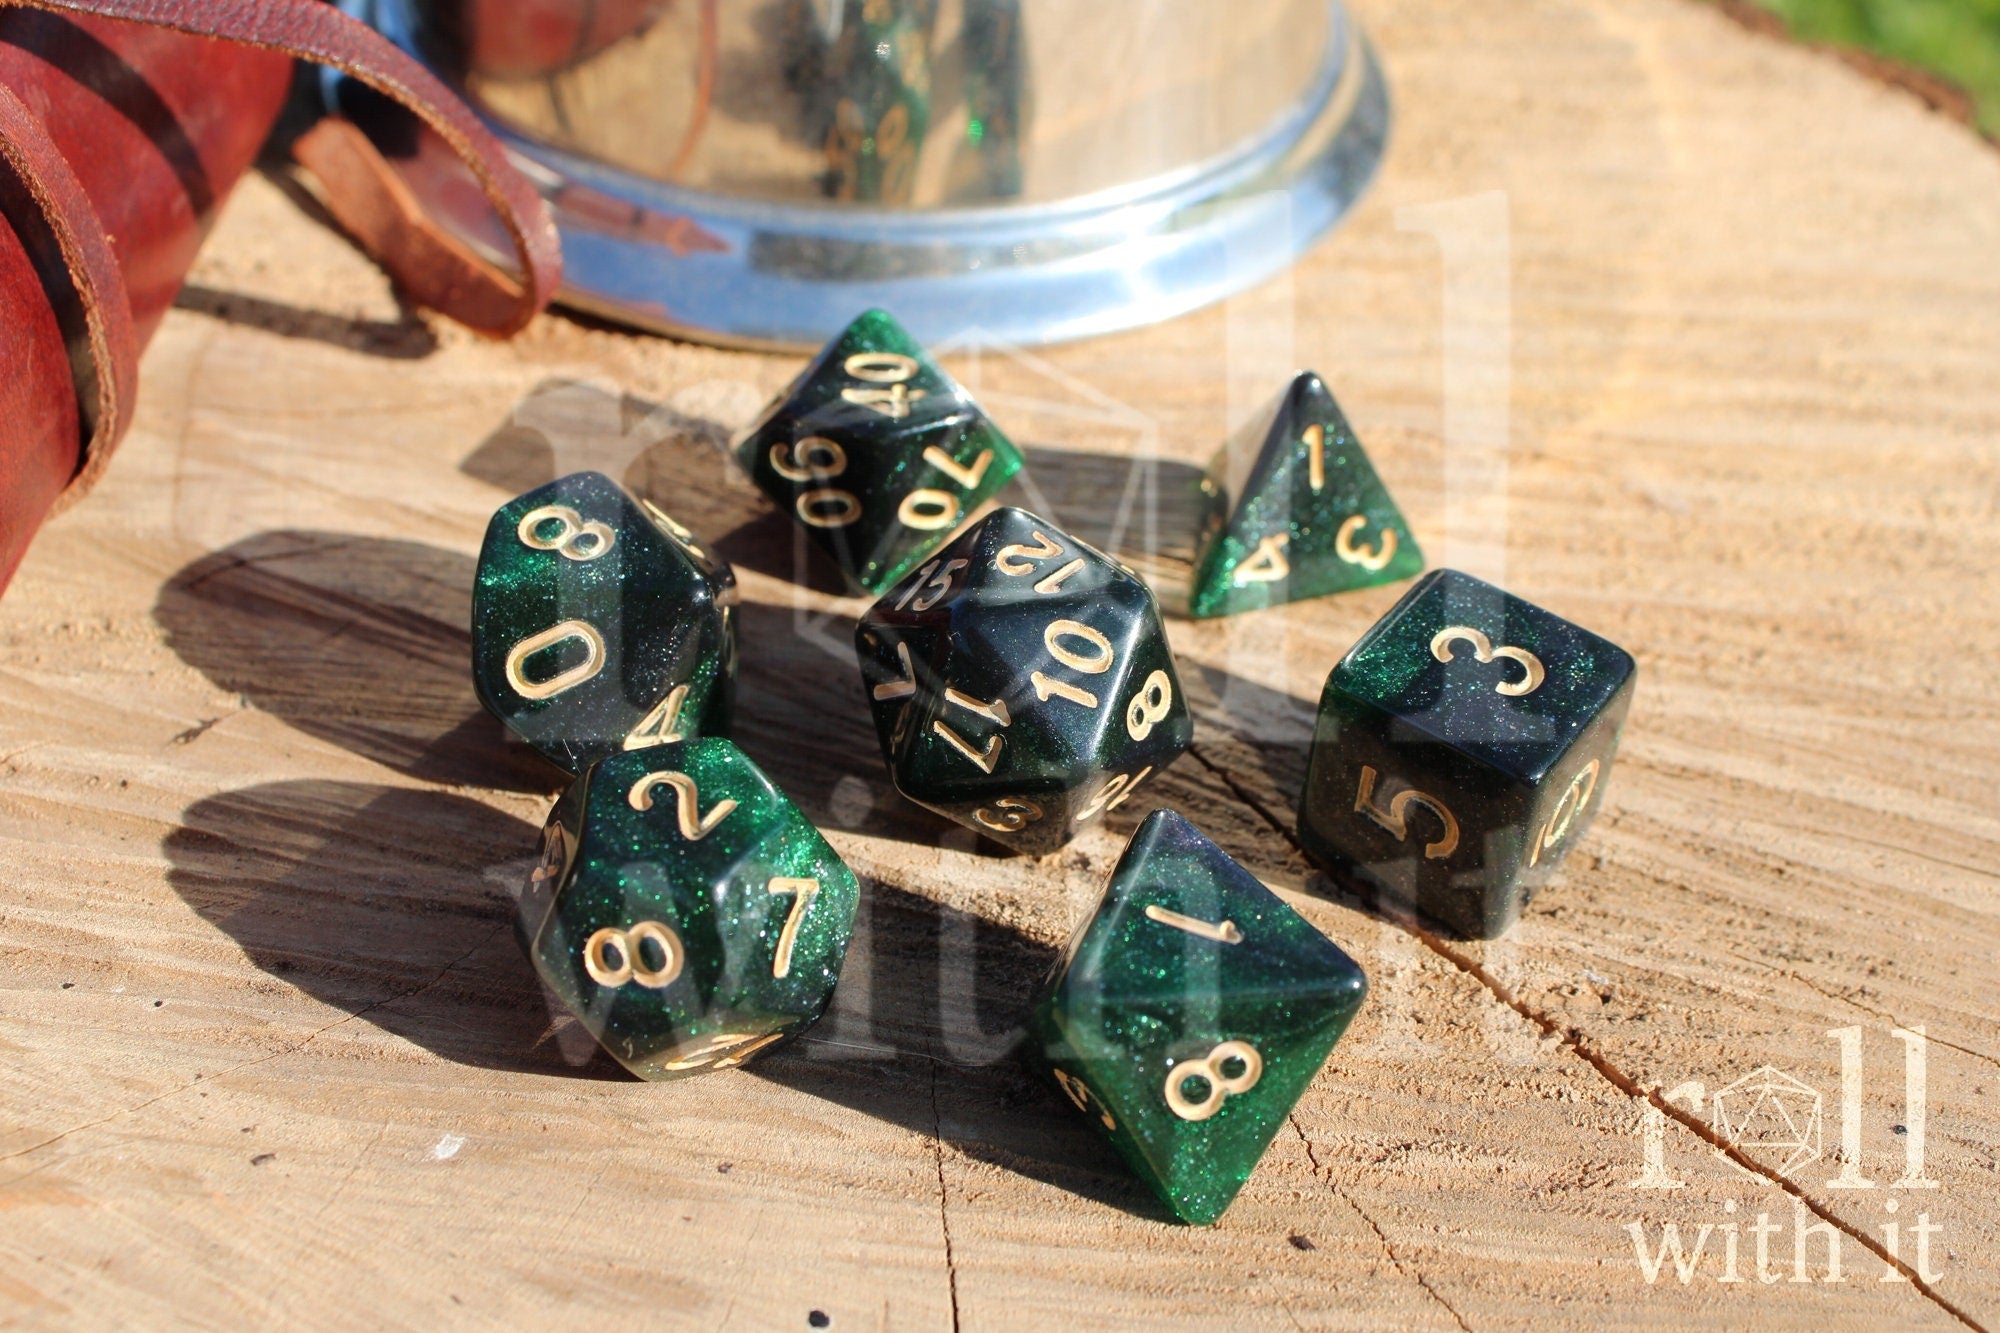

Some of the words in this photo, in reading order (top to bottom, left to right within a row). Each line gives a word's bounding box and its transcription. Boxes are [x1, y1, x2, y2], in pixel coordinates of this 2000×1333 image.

[841, 352, 926, 418] 40
[898, 446, 993, 530] 70
[1303, 424, 1325, 489] 1
[517, 505, 615, 561] 8
[996, 531, 1086, 594] 12
[1233, 533, 1290, 583] 4
[1336, 515, 1397, 571] 3
[895, 558, 968, 612] 15
[506, 620, 606, 700] 0
[1030, 619, 1114, 709] 10
[1430, 626, 1545, 697] 3
[623, 685, 689, 751] 4
[933, 687, 1012, 775] 17
[1126, 669, 1172, 742] 8
[628, 770, 738, 841] 2
[1353, 765, 1460, 859] 5
[584, 920, 685, 989] 8
[767, 876, 820, 979] 7
[1145, 904, 1245, 946] 1
[1164, 1040, 1263, 1122] 8
